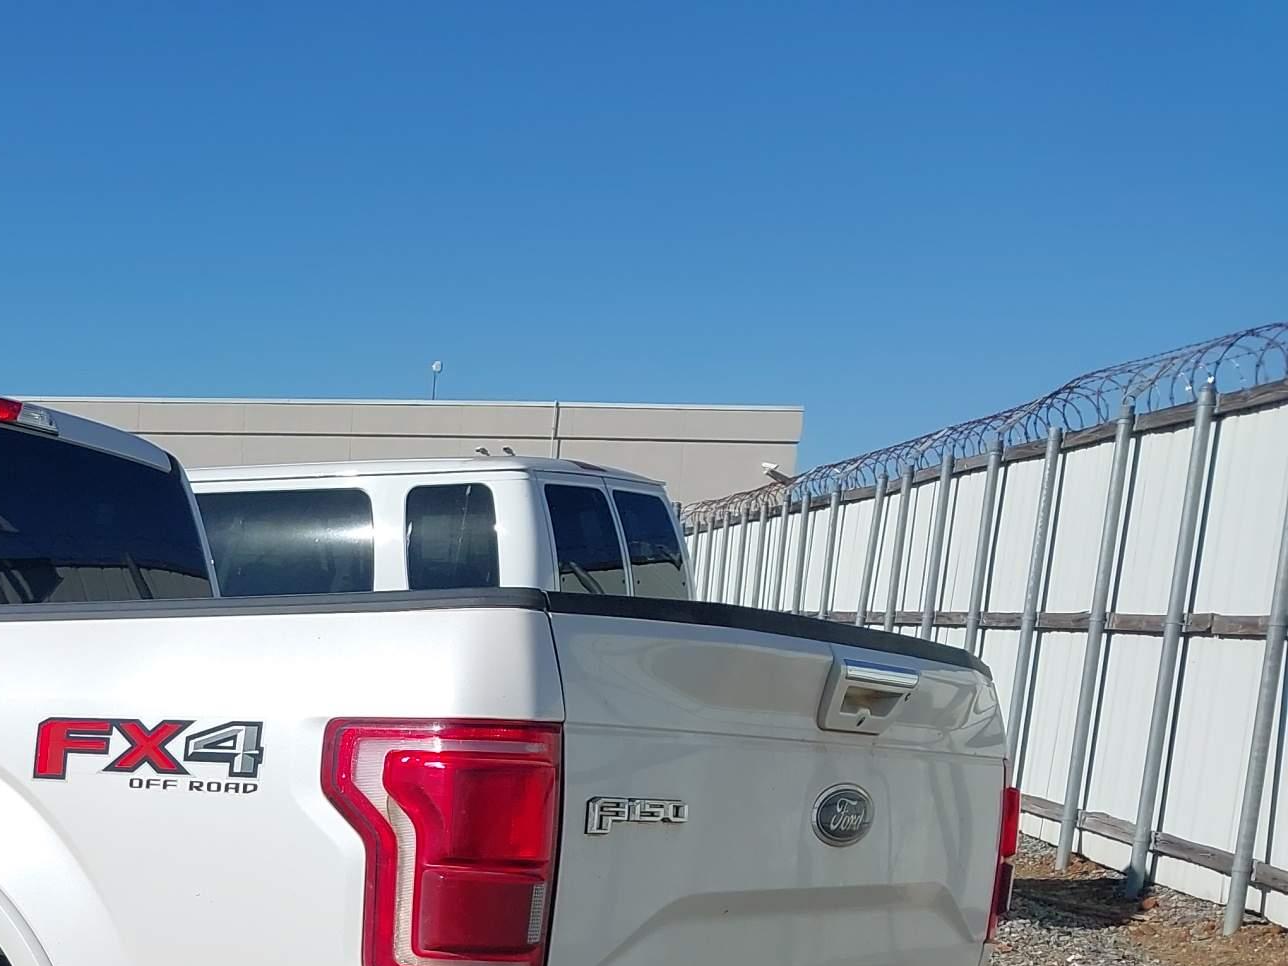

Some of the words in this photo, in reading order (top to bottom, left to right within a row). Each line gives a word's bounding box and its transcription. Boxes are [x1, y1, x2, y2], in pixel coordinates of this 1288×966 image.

[33, 717, 264, 779] FX4
[129, 777, 178, 790] OFF
[189, 780, 259, 793] ROAD
[830, 797, 865, 831] Ford
